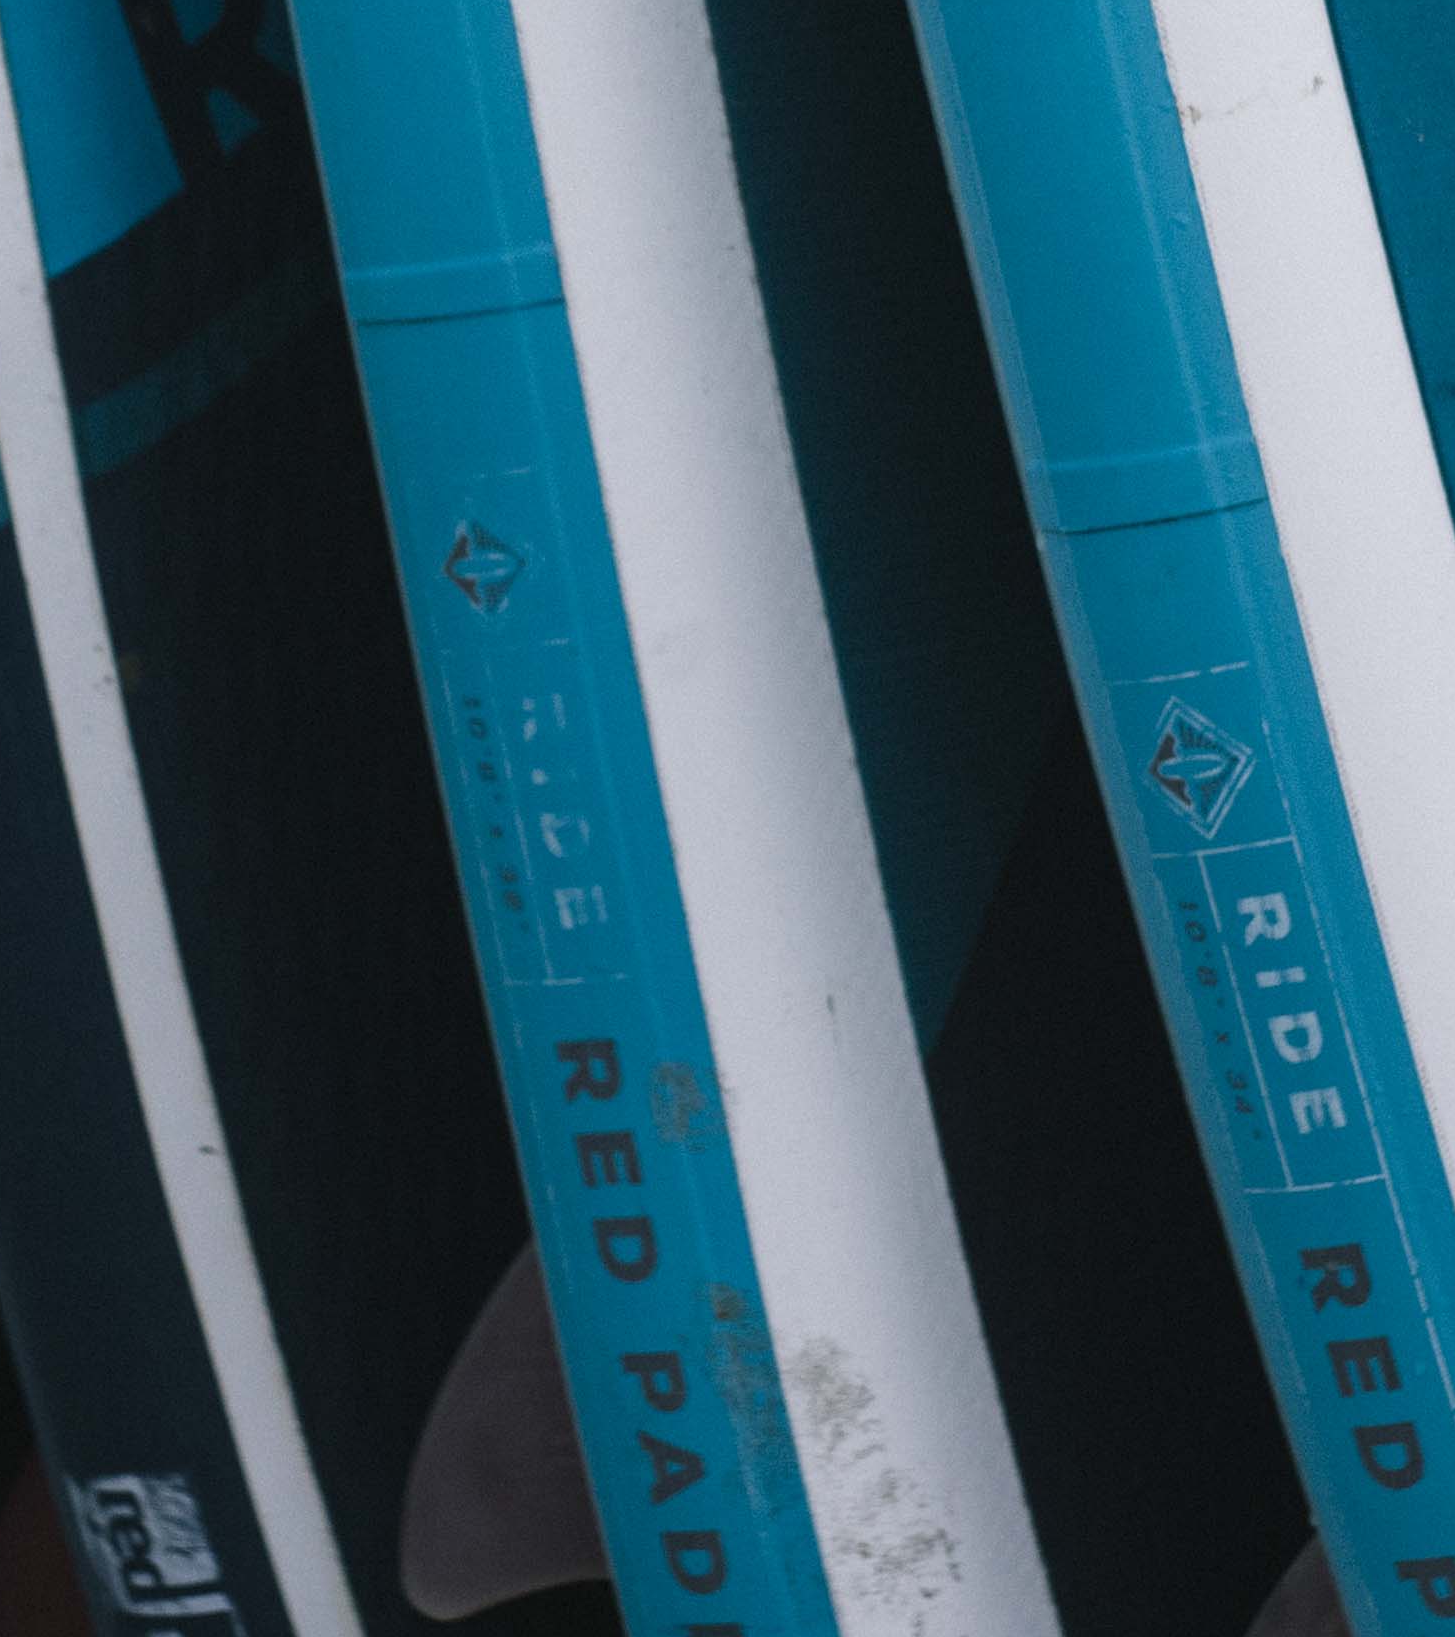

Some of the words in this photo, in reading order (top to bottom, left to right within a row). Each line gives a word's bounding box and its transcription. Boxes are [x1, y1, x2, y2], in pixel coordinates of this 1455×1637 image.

[1235, 891, 1346, 1135] RIDE
[556, 1037, 659, 1283] RED
[1298, 1242, 1426, 1491] RED
